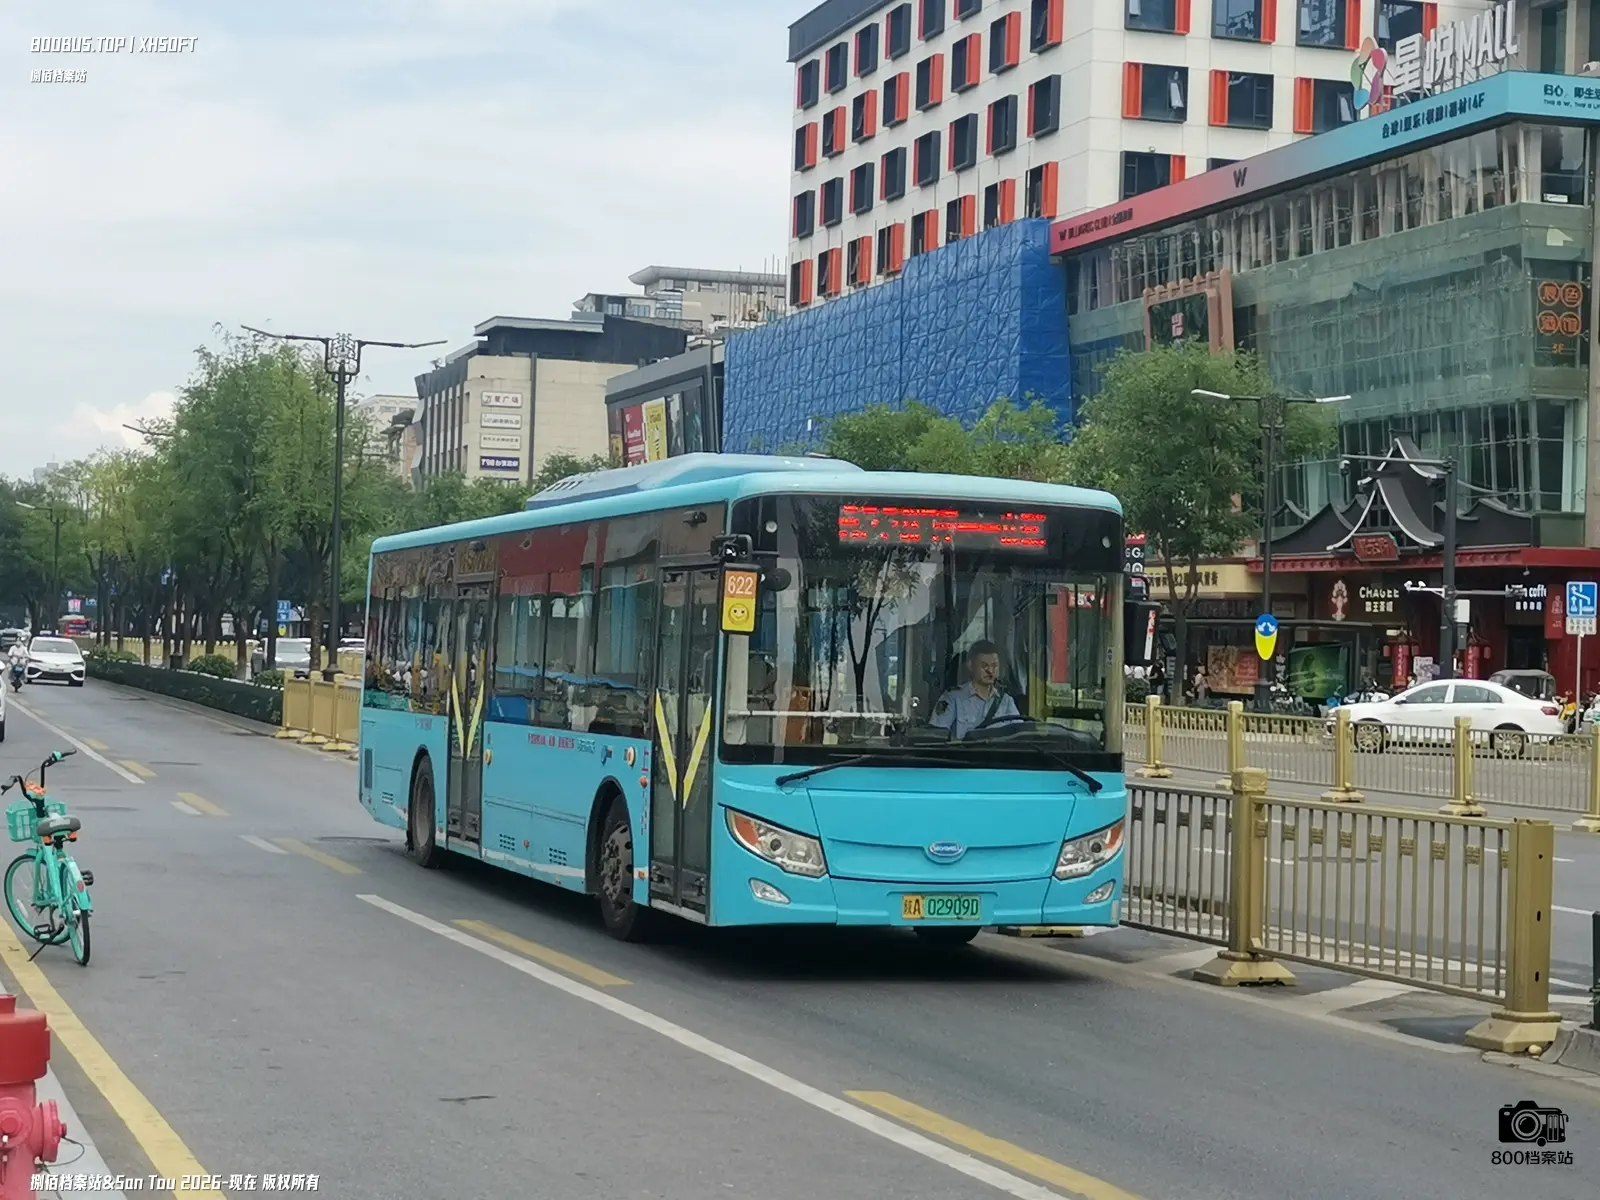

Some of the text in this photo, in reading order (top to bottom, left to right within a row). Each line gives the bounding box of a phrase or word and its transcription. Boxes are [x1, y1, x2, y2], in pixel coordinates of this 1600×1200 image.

[1233, 167, 1248, 188] W
[727, 575, 754, 595] 622
[1359, 586, 1400, 599] CHAGEE
[1528, 584, 1547, 598] coff
[927, 898, 979, 916] 02909D
